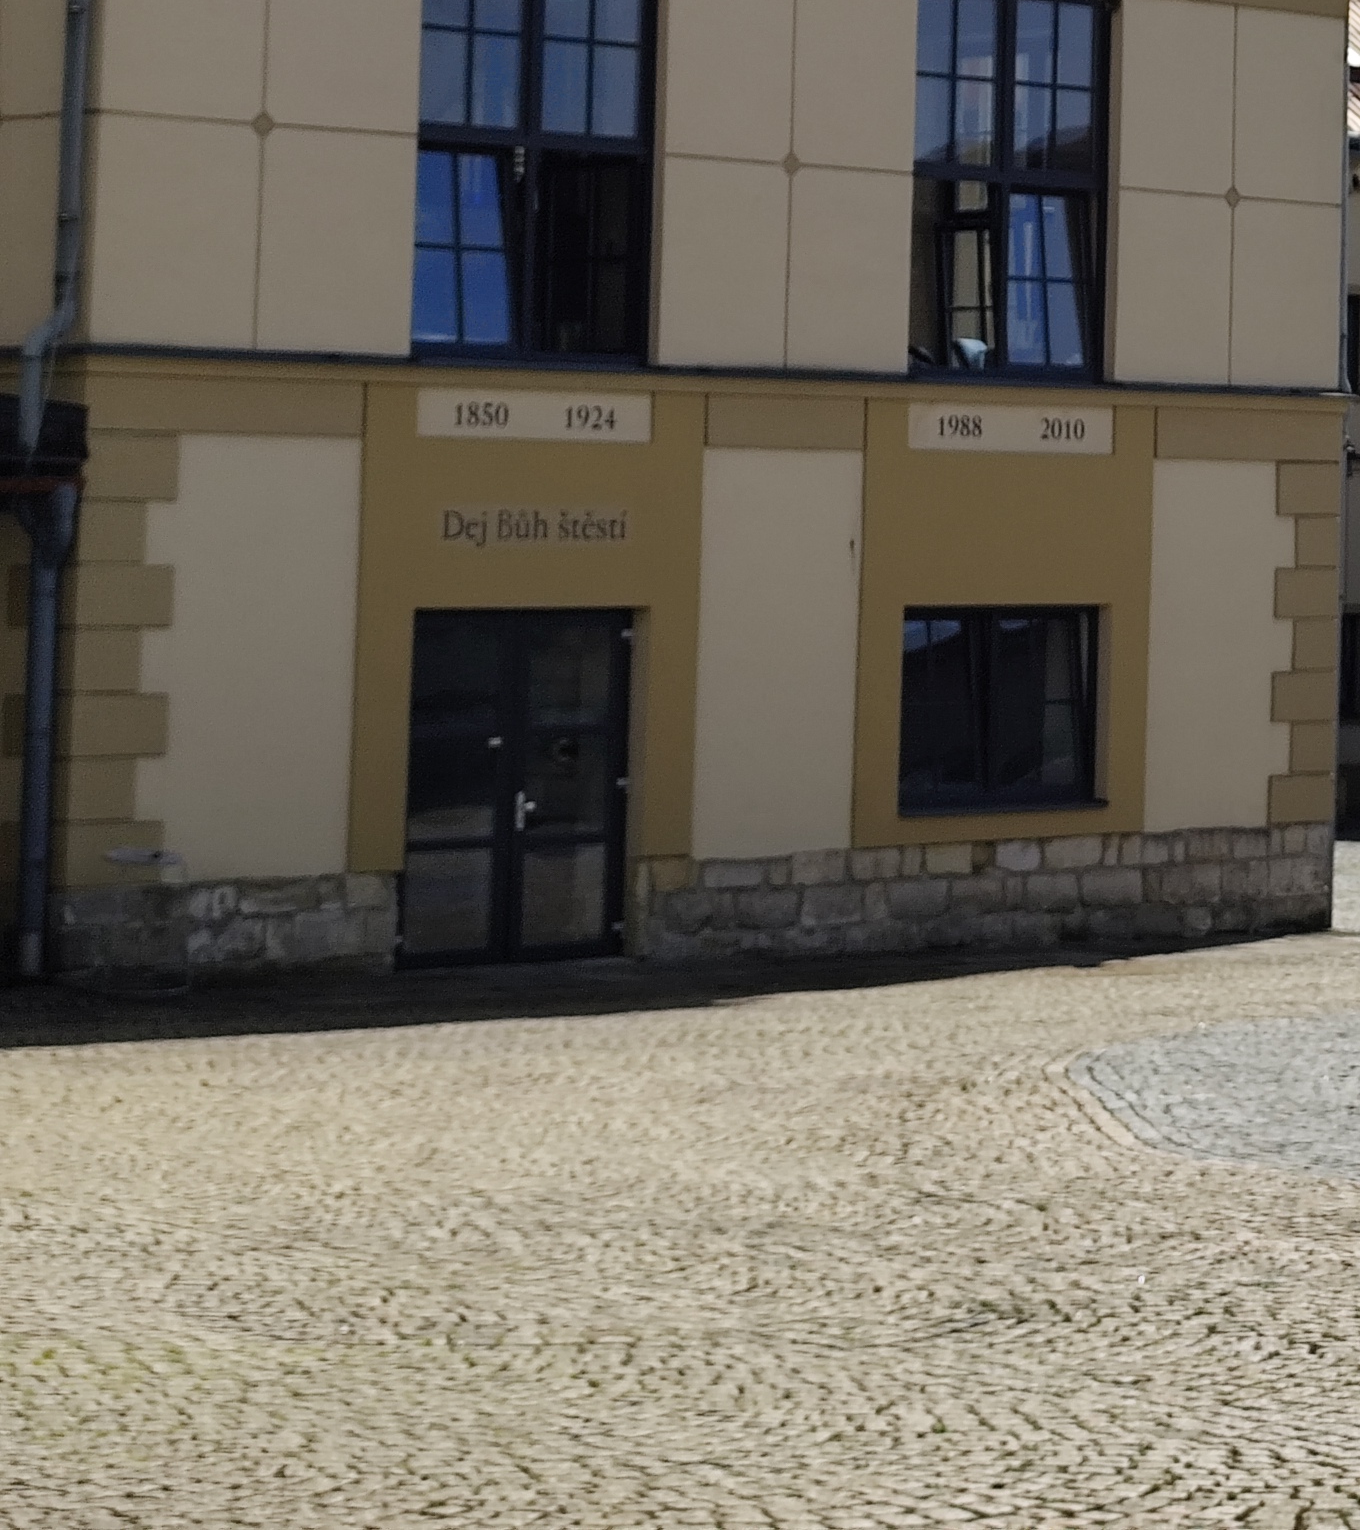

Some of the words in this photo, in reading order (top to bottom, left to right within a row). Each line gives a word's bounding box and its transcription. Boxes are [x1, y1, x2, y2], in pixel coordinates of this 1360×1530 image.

[454, 401, 510, 429] 1850
[565, 404, 617, 430] 1924
[937, 414, 983, 437] 1988
[1040, 417, 1085, 440] 2010
[442, 509, 488, 547] Dej
[497, 508, 549, 540] Bůh
[558, 508, 628, 540] štěstí
